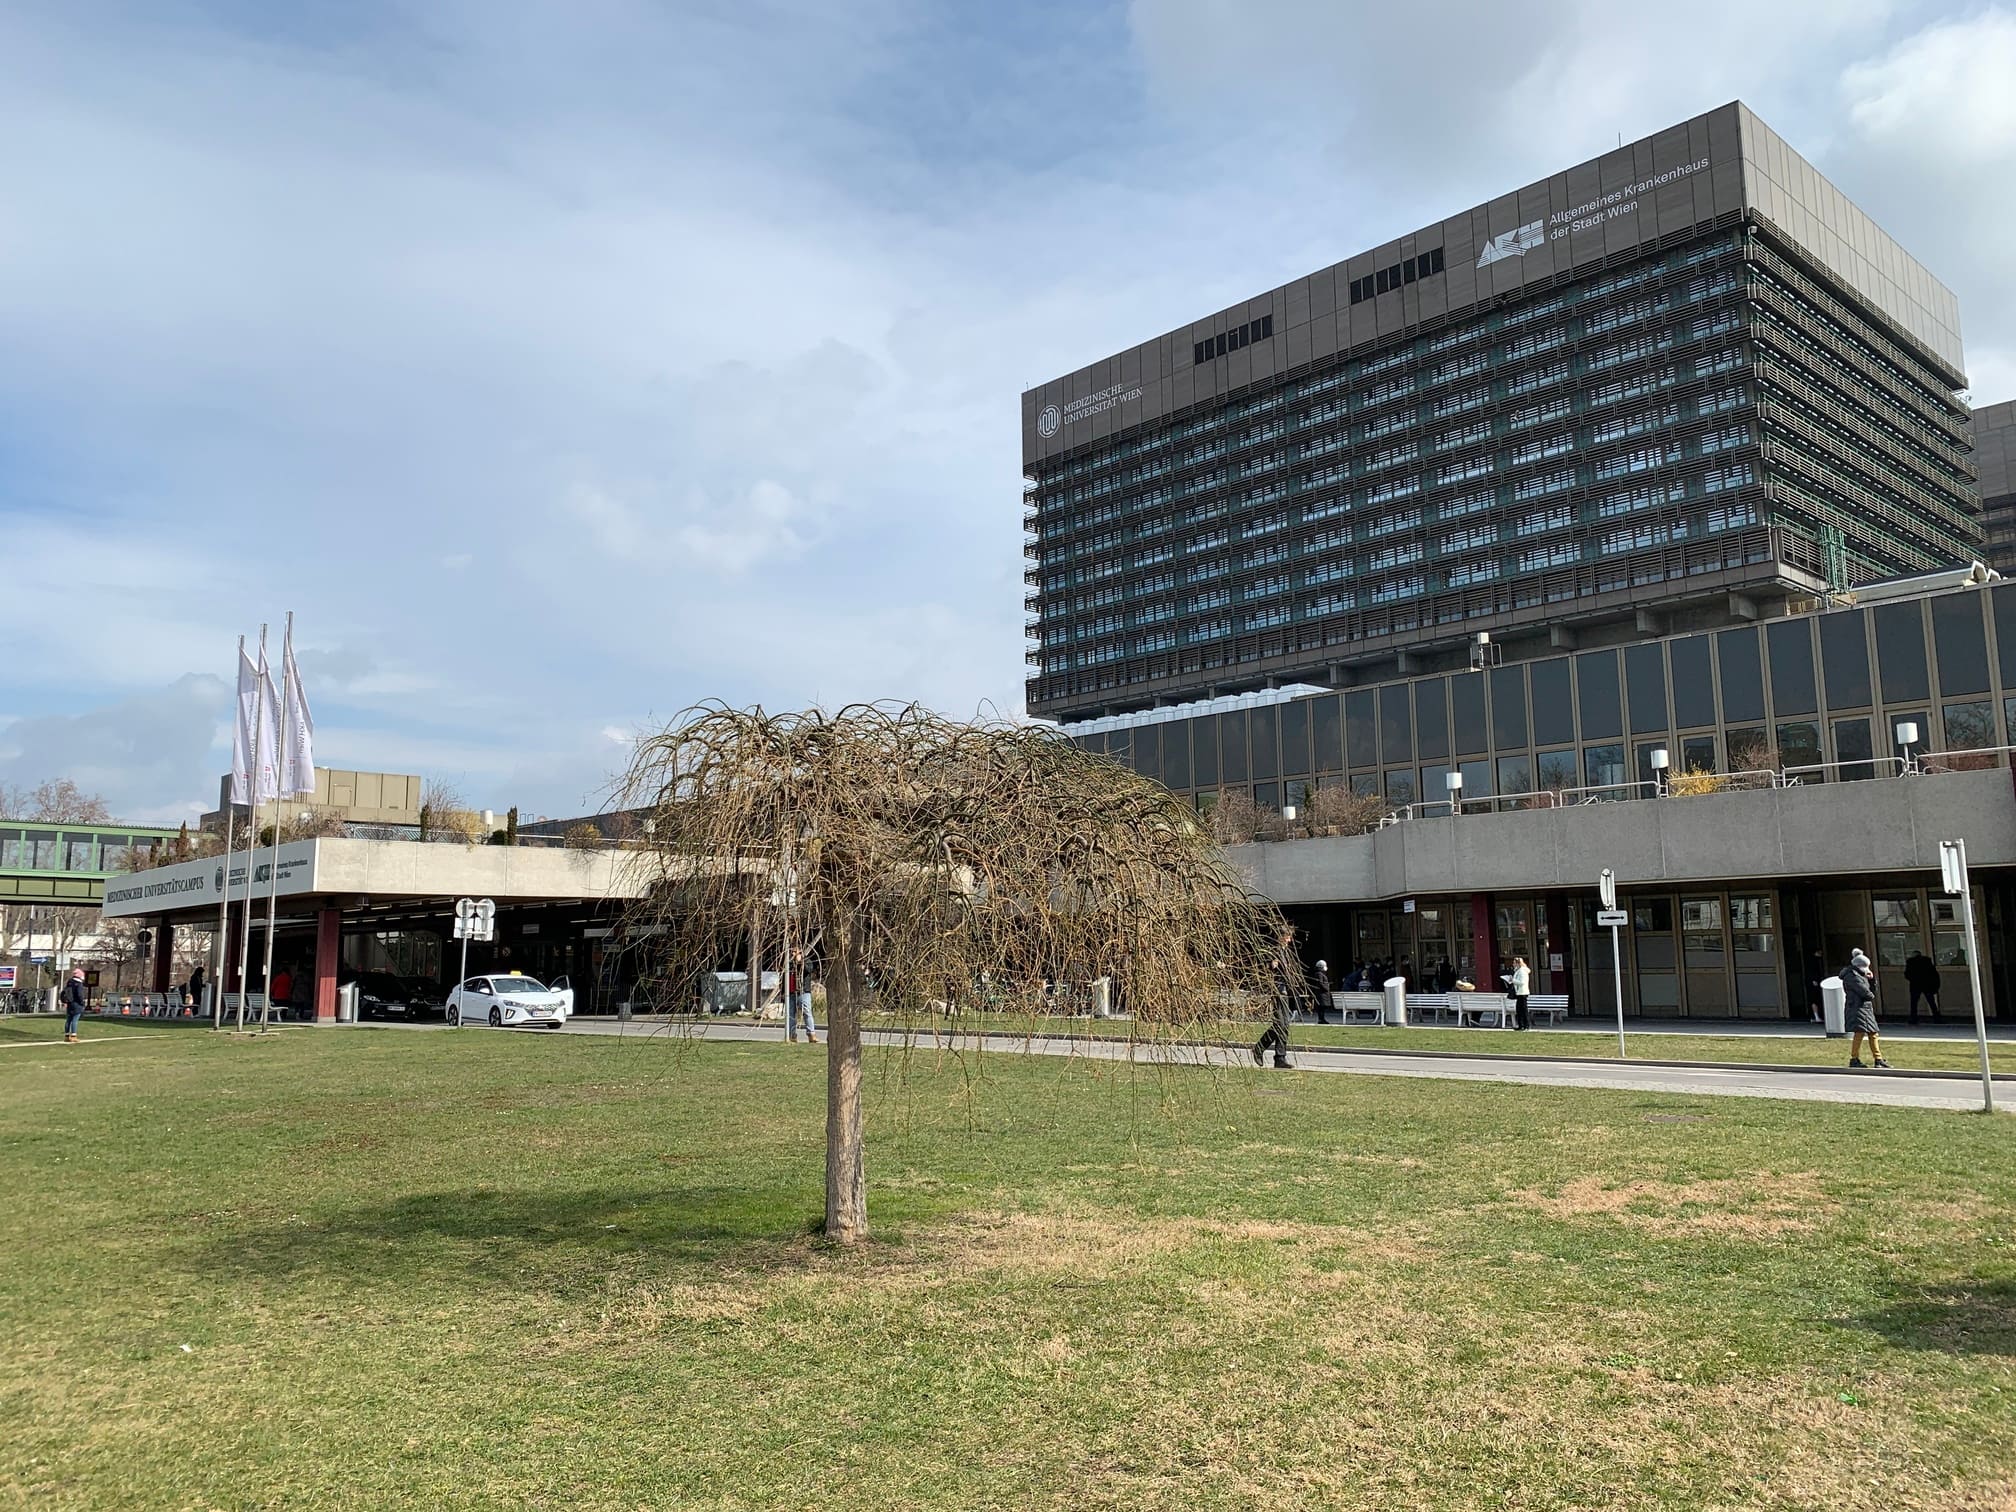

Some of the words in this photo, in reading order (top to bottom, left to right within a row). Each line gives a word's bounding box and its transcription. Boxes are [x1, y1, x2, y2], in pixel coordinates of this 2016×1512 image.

[1549, 191, 1622, 226] Allgemeines
[1624, 157, 1709, 198] Krankenhaus
[1550, 224, 1570, 240] der
[1572, 212, 1606, 232] Stadt
[1607, 201, 1638, 220] Wien
[1063, 383, 1123, 414] MEDIZINISCHE
[1119, 387, 1143, 403] WIEN
